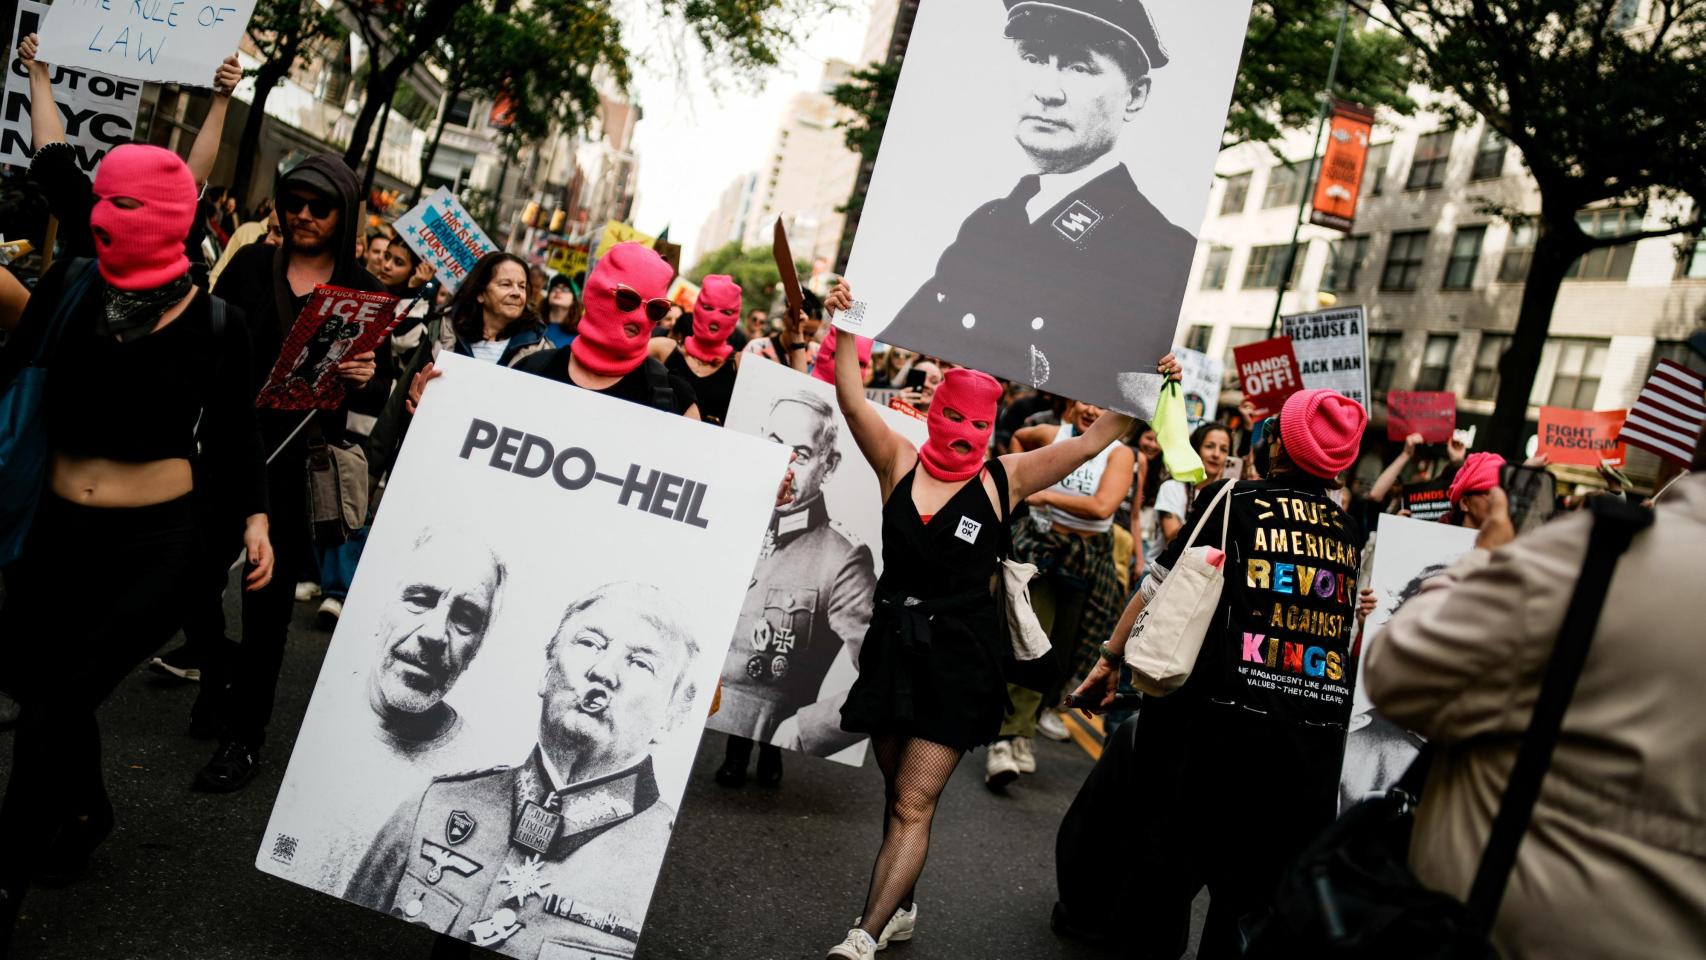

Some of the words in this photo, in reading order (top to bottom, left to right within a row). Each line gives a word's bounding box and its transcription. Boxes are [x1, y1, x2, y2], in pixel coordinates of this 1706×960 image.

[197, 6, 236, 29] OF
[88, 25, 166, 64] LAW
[88, 76, 139, 100] OF
[5, 91, 132, 145] NYC
[441, 210, 461, 232] THIS
[456, 230, 468, 243] IS
[419, 226, 448, 257] LOOKS
[443, 255, 466, 278] LIKE
[430, 218, 474, 269] DEMOCRACY
[332, 290, 353, 298] FUCK
[318, 297, 383, 323] ICE
[1286, 321, 1346, 340] BECAUSE
[1349, 321, 1359, 335] A
[1242, 355, 1290, 376] HANDS
[1332, 356, 1361, 371] MAN
[1246, 367, 1295, 396] OFF!
[1545, 434, 1618, 449] FASCISM
[1546, 424, 1594, 437] FIGHT
[1409, 490, 1444, 501] HANDS
[1276, 497, 1330, 527] TRUE
[962, 520, 978, 531] NOT
[962, 528, 972, 537] OK
[1271, 602, 1344, 638] AGAINST
[1247, 679, 1275, 689] VALUES
[1283, 686, 1302, 695] THEY
[1303, 690, 1318, 699] CAN
[1250, 669, 1271, 680] MAGA
[1304, 680, 1319, 689] LIKE
